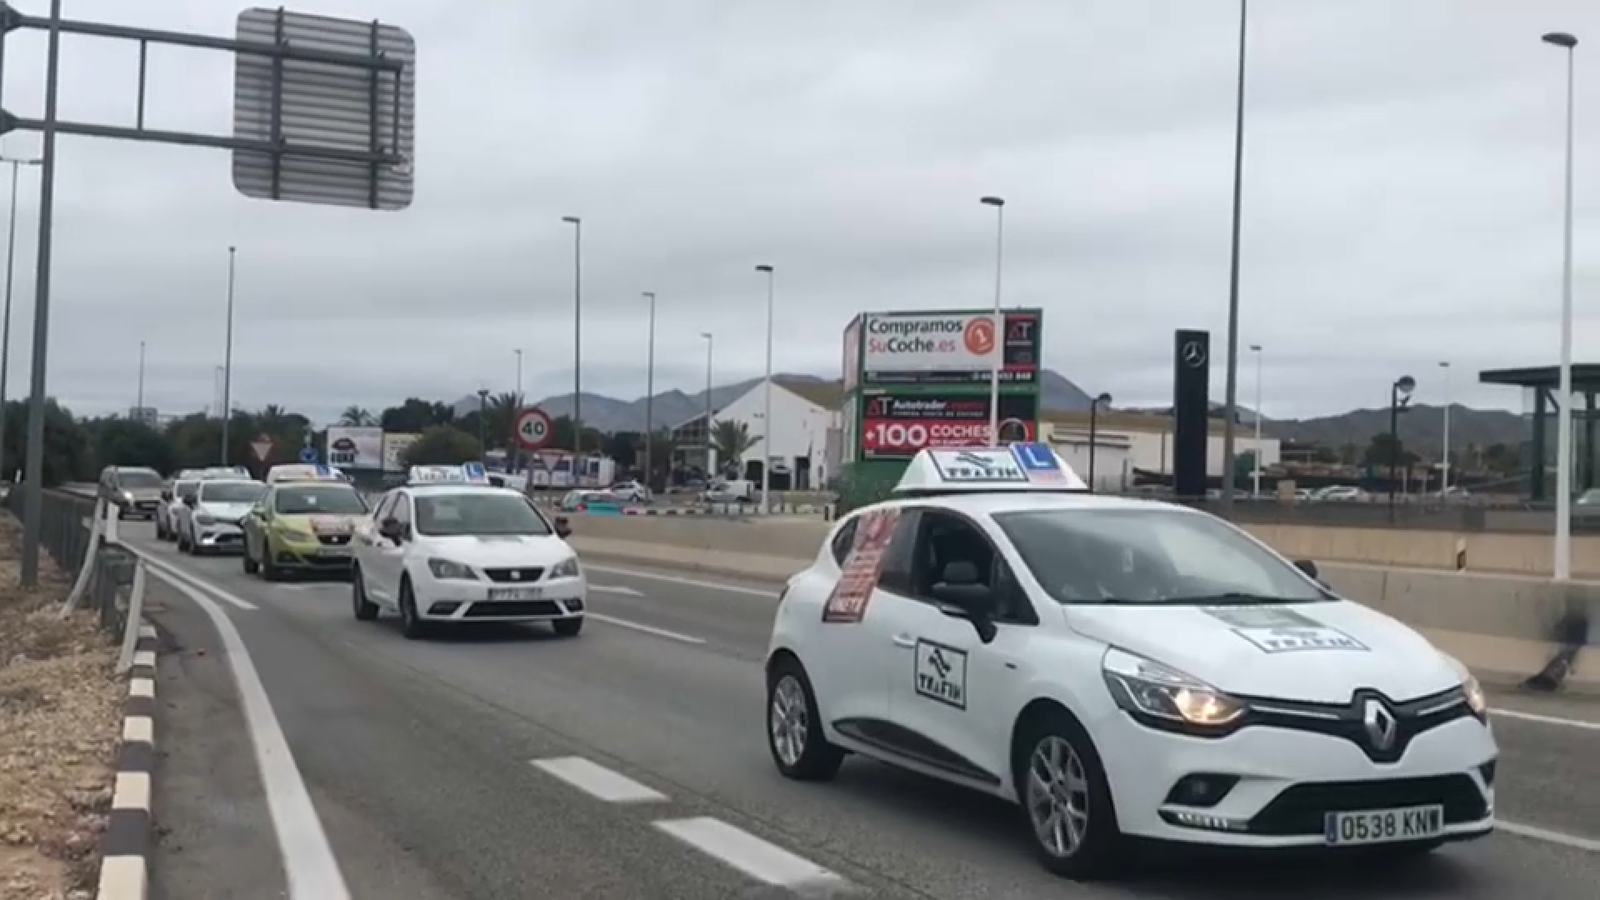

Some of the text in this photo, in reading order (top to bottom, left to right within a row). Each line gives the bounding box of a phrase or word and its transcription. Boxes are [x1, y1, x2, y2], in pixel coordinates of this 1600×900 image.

[869, 318, 963, 336] Compramos
[869, 337, 956, 353] SuCoche.es
[521, 421, 544, 435] 40
[865, 424, 993, 446] +100 COCHES
[1026, 446, 1050, 466] L
[1341, 812, 1396, 840] 0538
